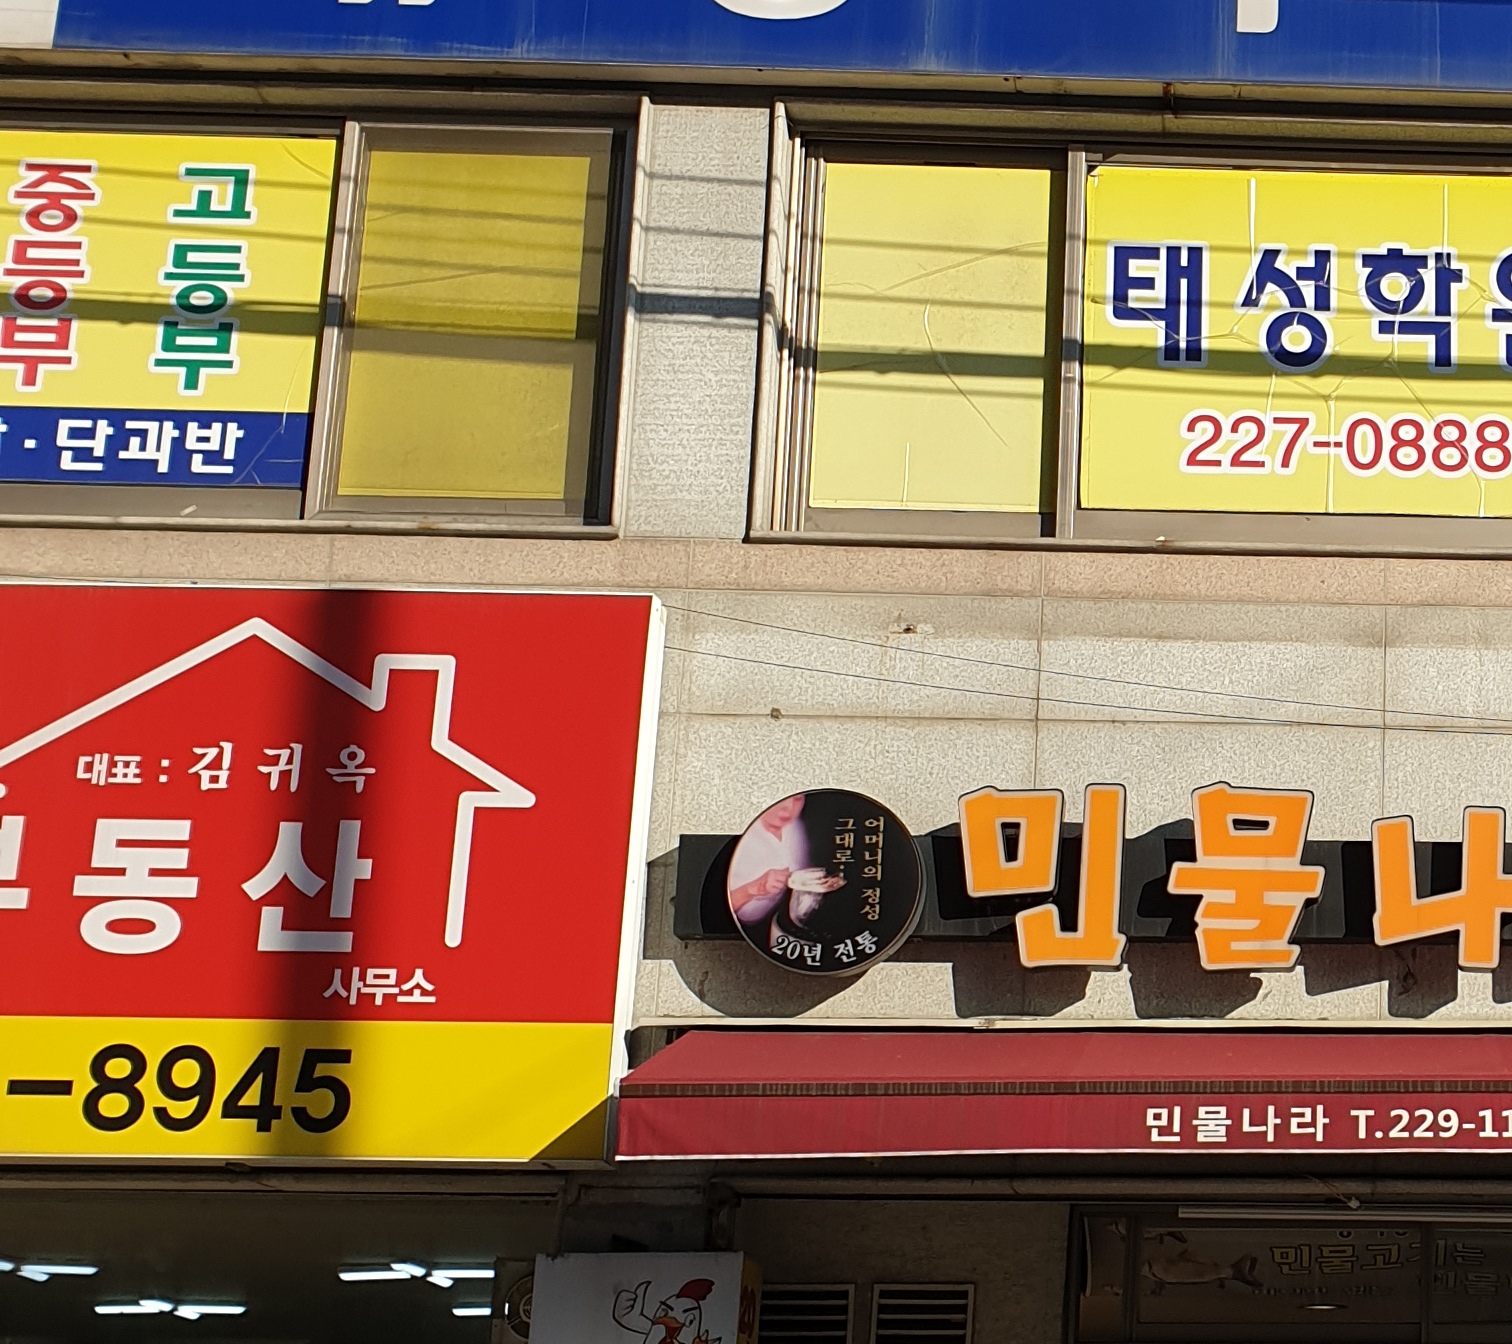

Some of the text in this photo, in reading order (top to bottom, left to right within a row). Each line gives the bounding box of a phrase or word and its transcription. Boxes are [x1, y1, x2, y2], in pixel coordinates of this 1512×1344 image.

[0, 163, 96, 387] 중등부
[154, 167, 252, 391] 고등부
[1186, 414, 1512, 473] 227-0888
[188, 741, 376, 793] 김귀옥
[861, 816, 884, 920] 어머니의 정성
[771, 931, 879, 965] 20년 전통
[323, 968, 436, 1004] 사무소
[1145, 1105, 1330, 1143] 민물나라
